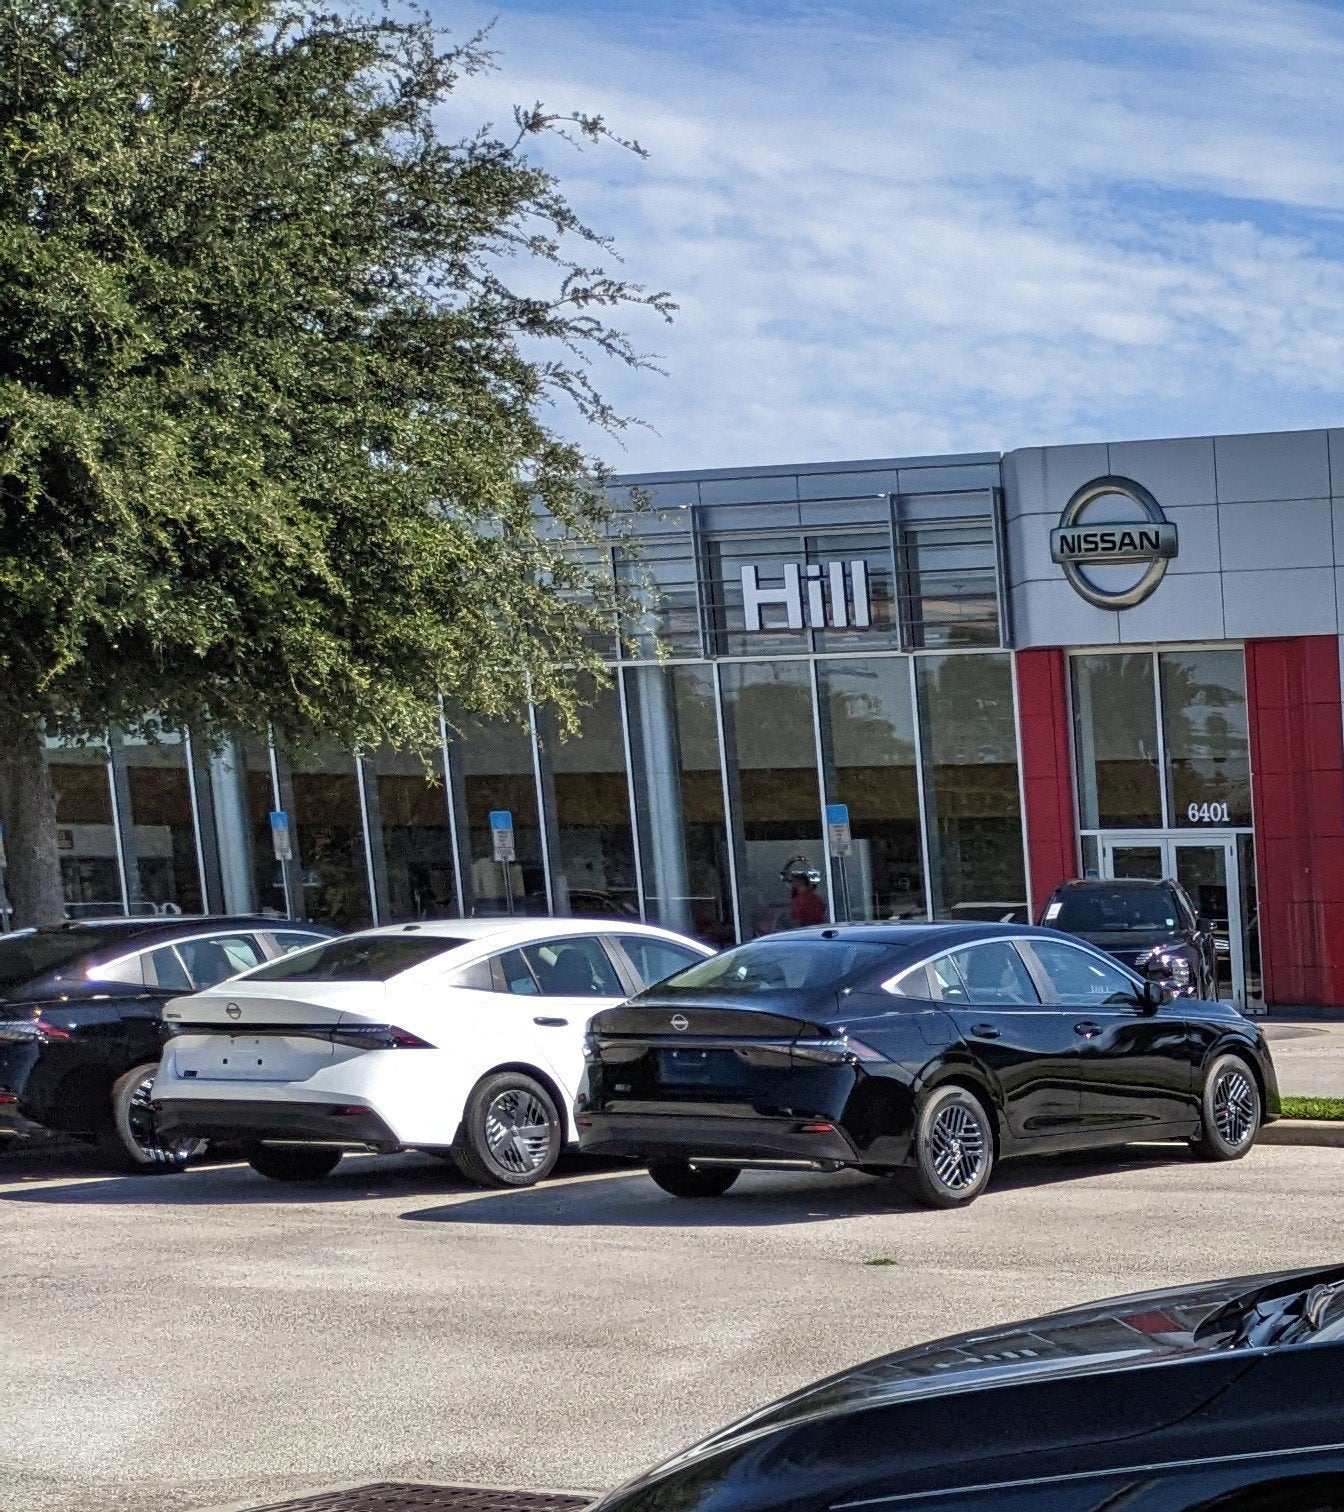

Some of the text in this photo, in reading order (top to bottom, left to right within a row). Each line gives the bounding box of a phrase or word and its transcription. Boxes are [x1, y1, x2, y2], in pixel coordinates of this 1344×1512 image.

[1059, 530, 1161, 556] NISSAN
[740, 560, 870, 631] Hill
[1187, 802, 1230, 823] 6401
